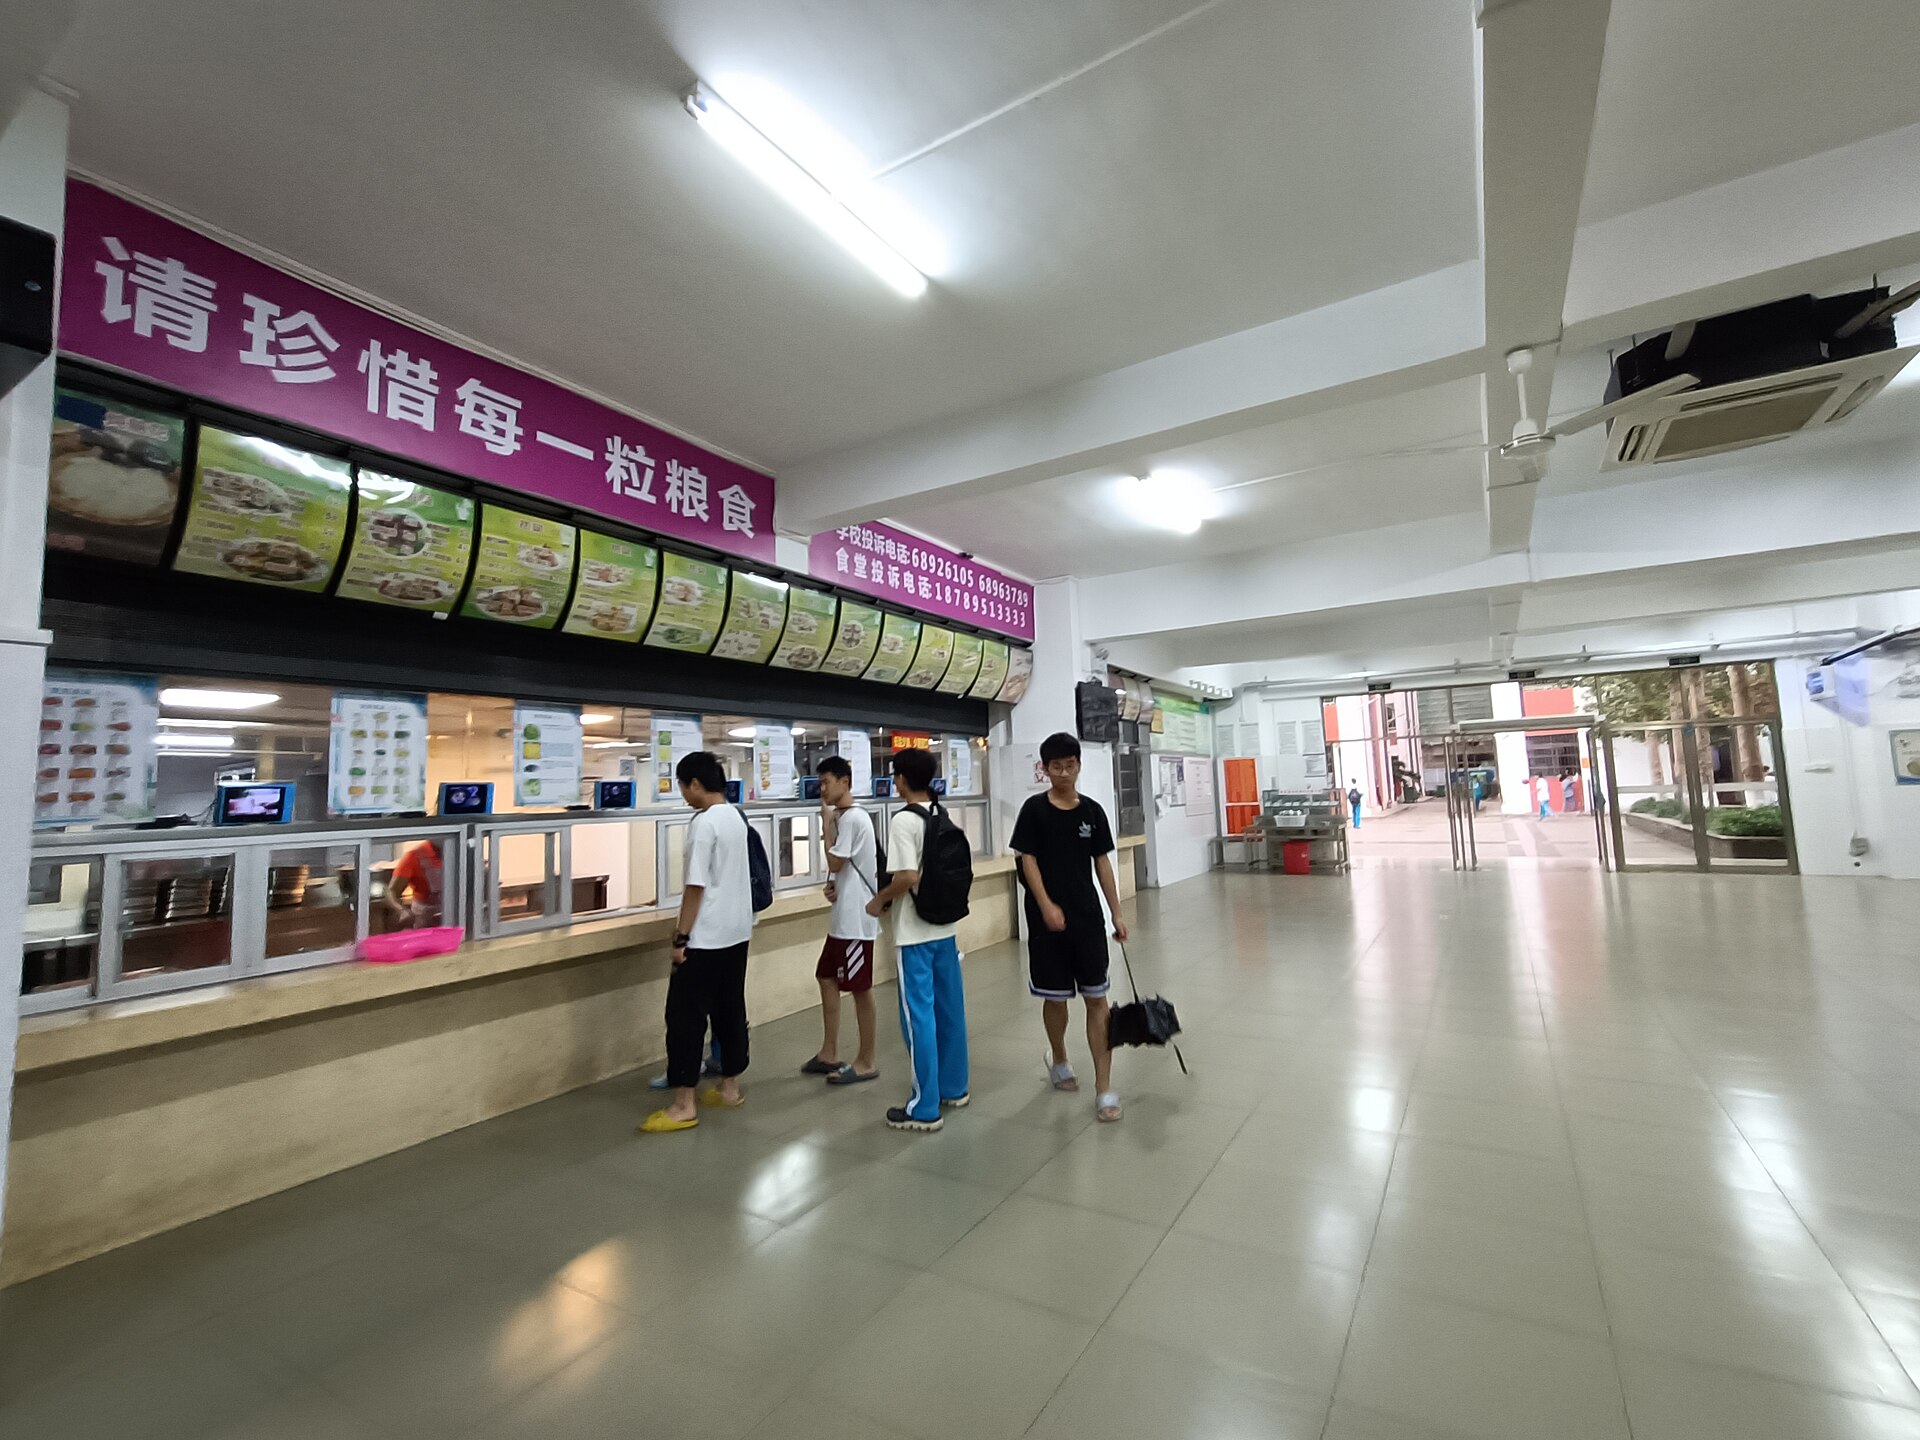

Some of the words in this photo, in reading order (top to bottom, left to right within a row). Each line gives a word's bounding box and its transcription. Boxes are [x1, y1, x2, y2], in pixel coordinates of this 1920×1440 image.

[95, 235, 757, 539] 请珍惜每一粒粮食
[978, 574, 1029, 607] 68963789
